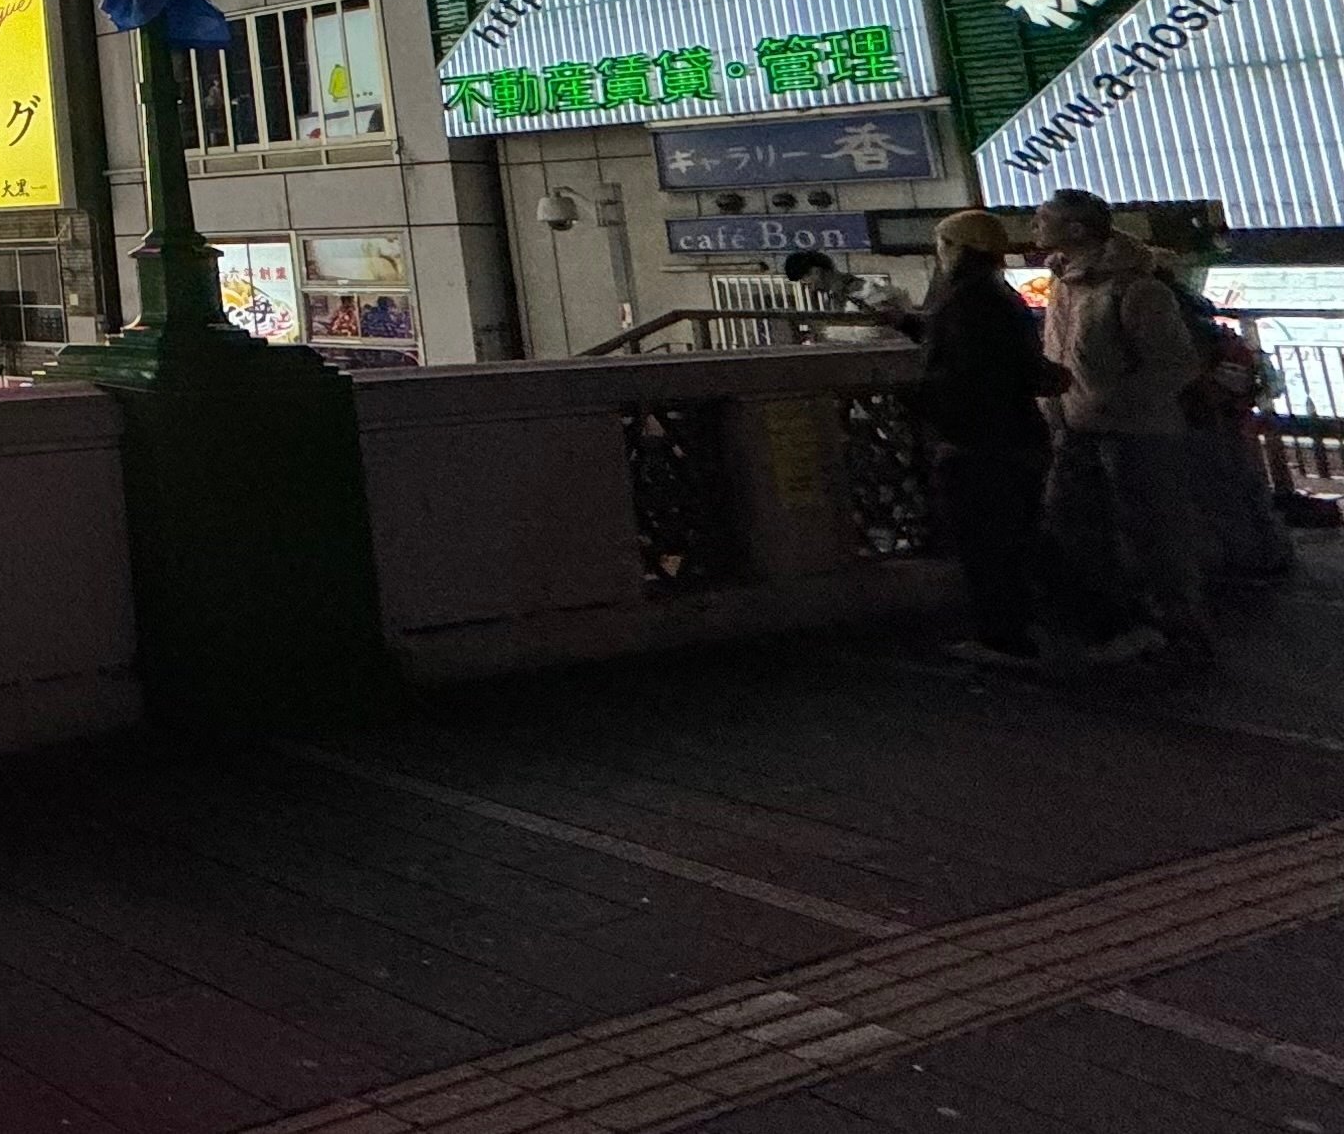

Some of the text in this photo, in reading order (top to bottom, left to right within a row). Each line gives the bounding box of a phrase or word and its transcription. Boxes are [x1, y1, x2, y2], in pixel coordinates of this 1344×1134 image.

[443, 24, 900, 124] 不動産賃貸・管理
[666, 122, 917, 174] ギャラリー 香
[678, 220, 846, 251] café Bon
